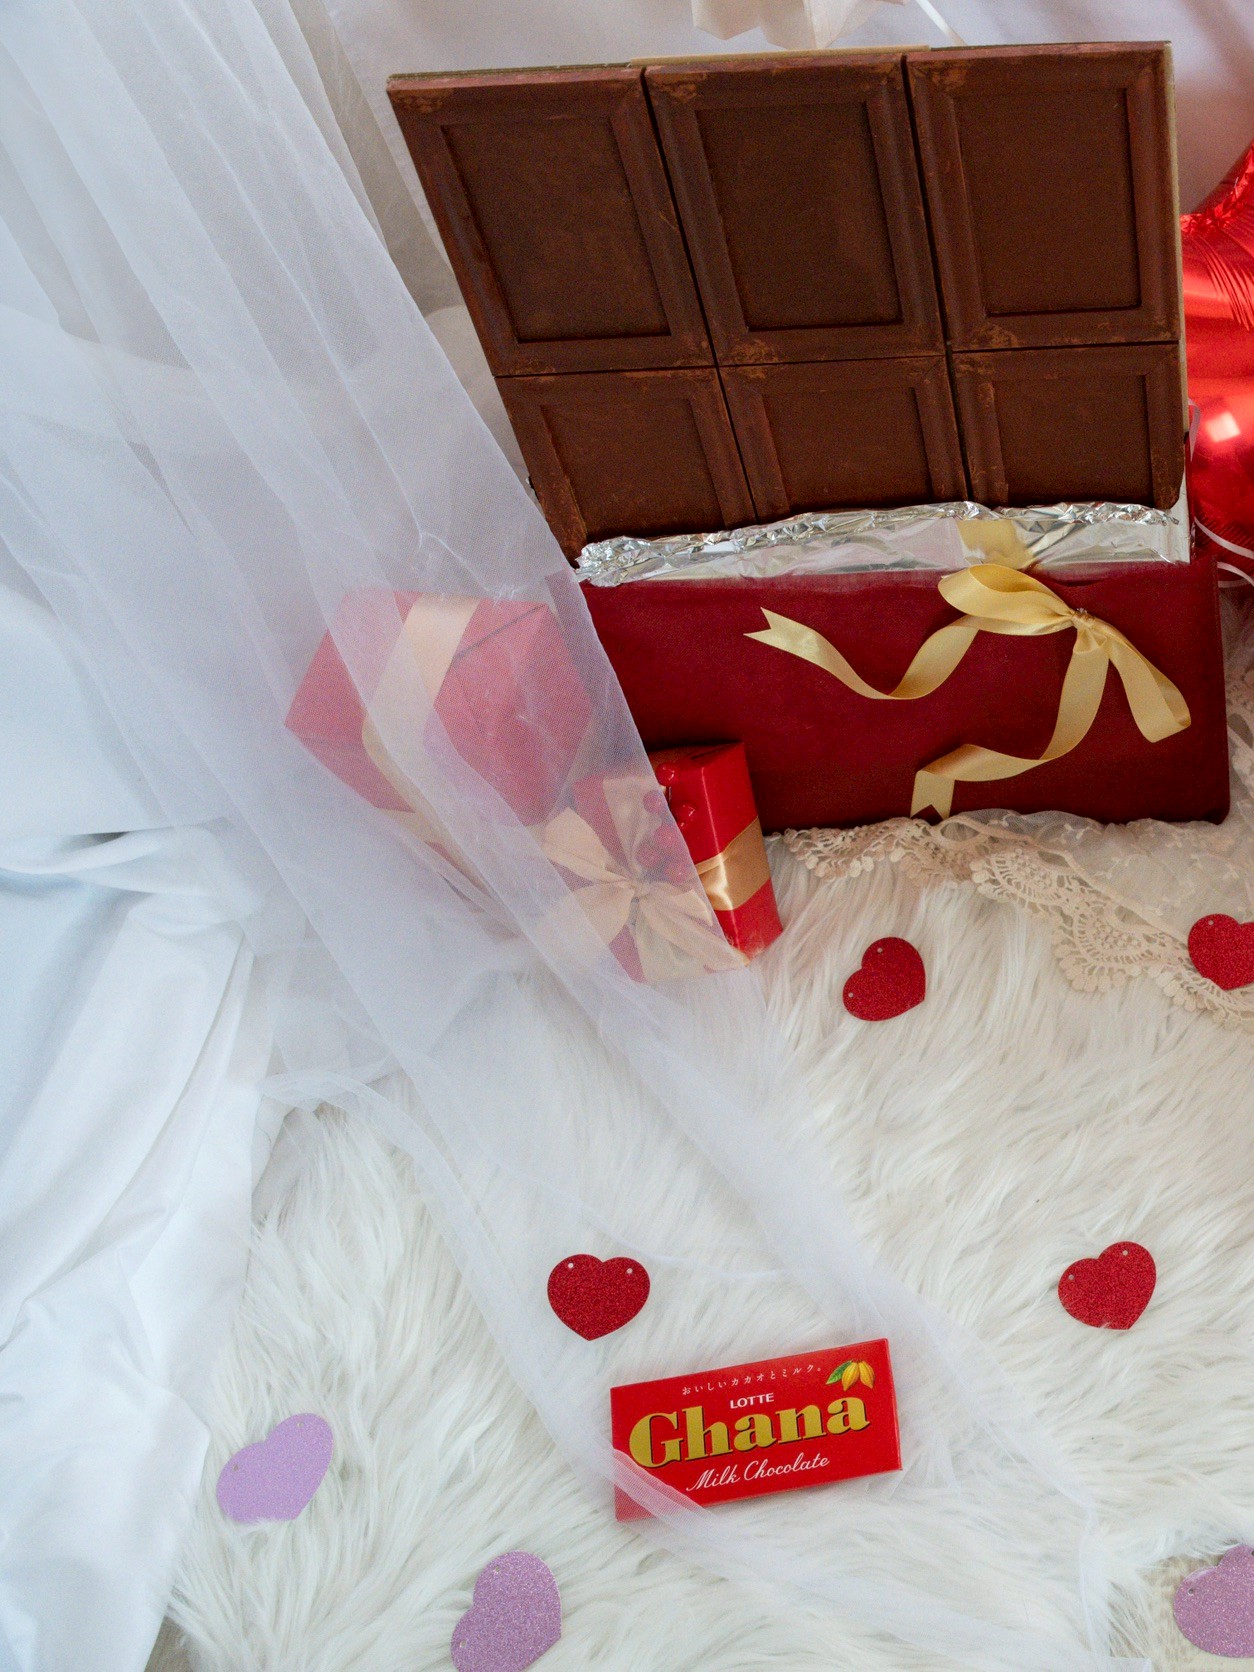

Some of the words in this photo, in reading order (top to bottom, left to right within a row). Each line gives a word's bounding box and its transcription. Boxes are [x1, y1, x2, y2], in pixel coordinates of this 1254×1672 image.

[682, 1364, 822, 1396] おいしいカカオとミルク。
[730, 1392, 775, 1410] LOTTE
[628, 1395, 871, 1469] Ghana
[685, 1462, 741, 1492] Milk
[743, 1452, 831, 1482] Chocolate
